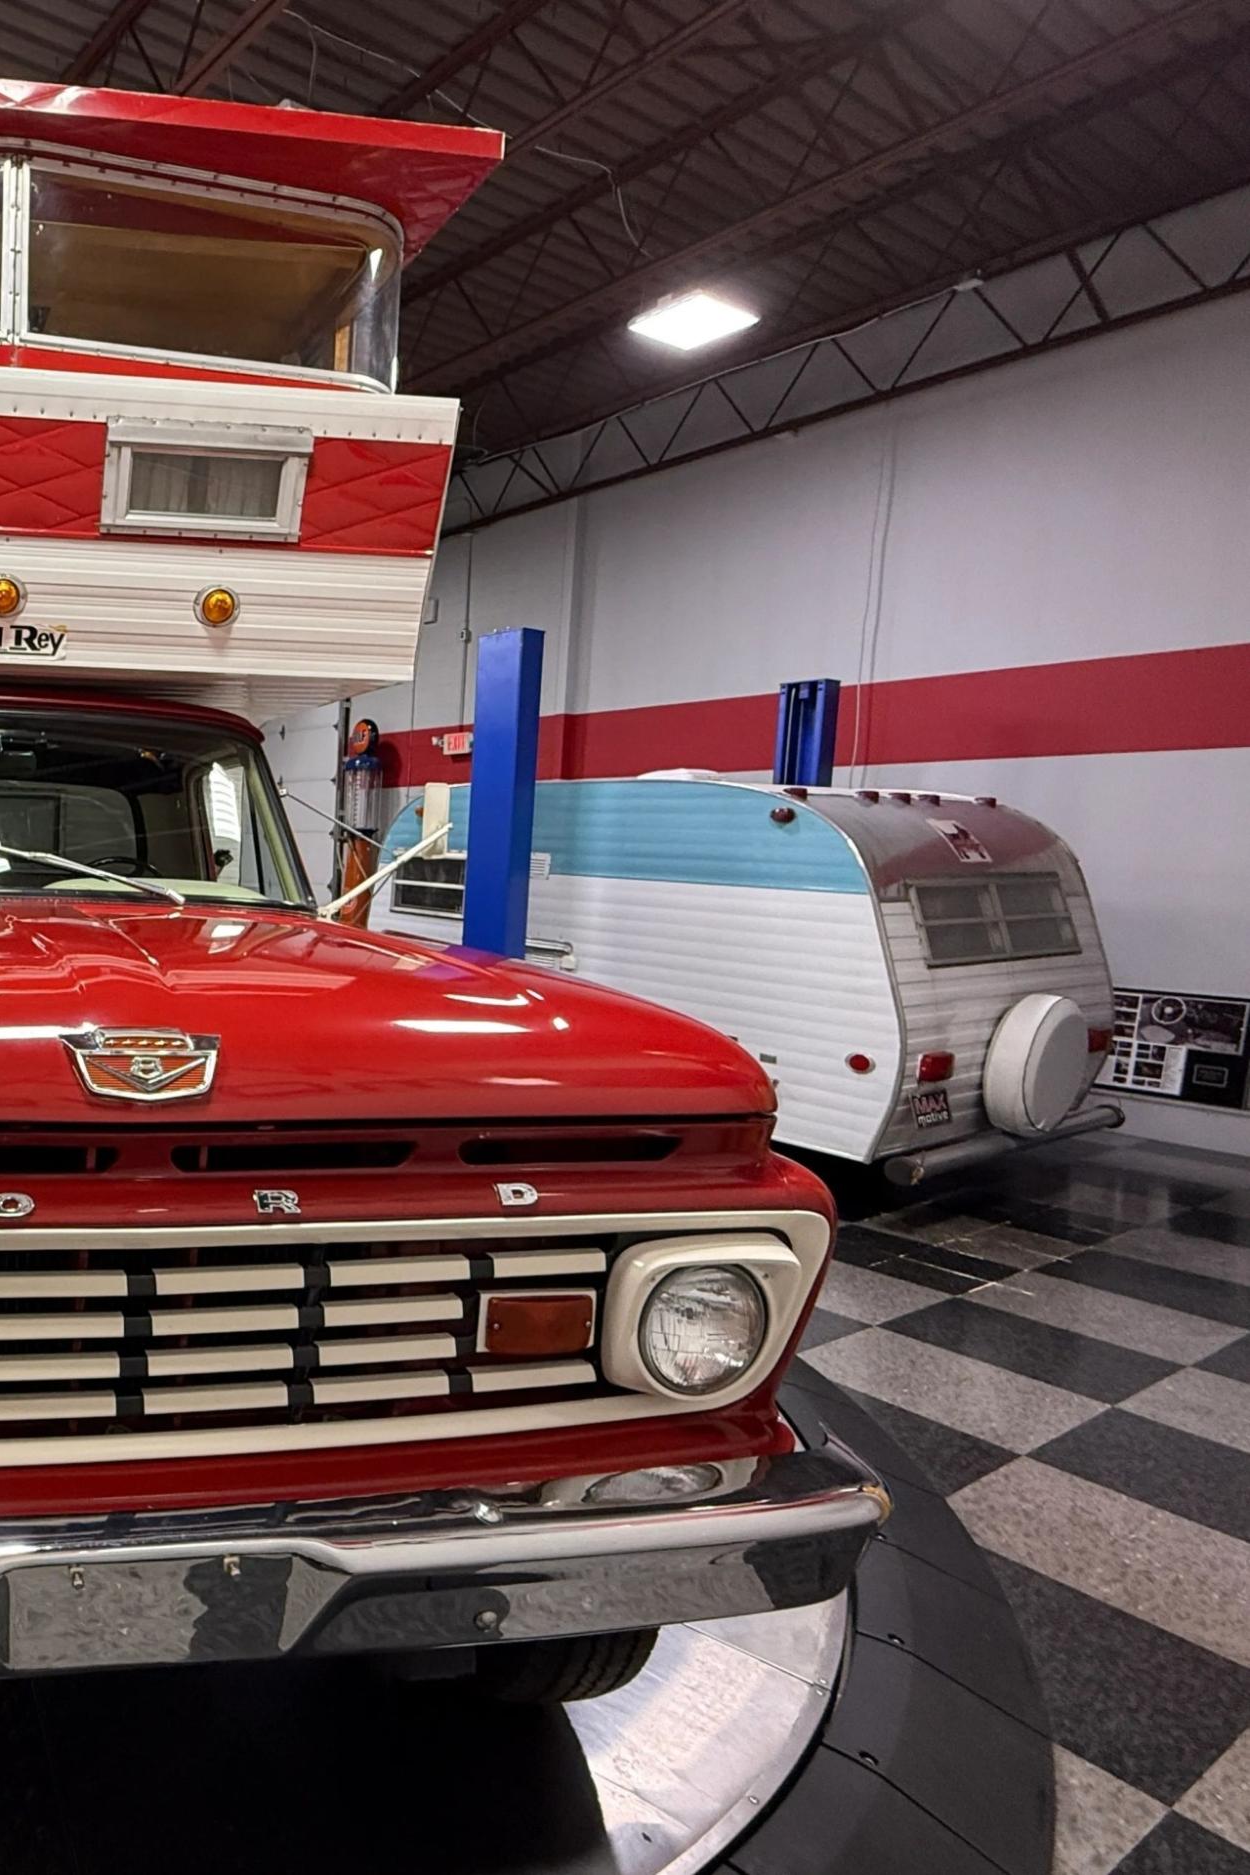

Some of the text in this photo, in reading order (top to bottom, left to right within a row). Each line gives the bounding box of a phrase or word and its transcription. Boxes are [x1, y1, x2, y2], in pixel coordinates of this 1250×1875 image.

[10, 625, 66, 656] Rey
[447, 734, 466, 752] EXIT
[913, 1092, 948, 1115] MAX
